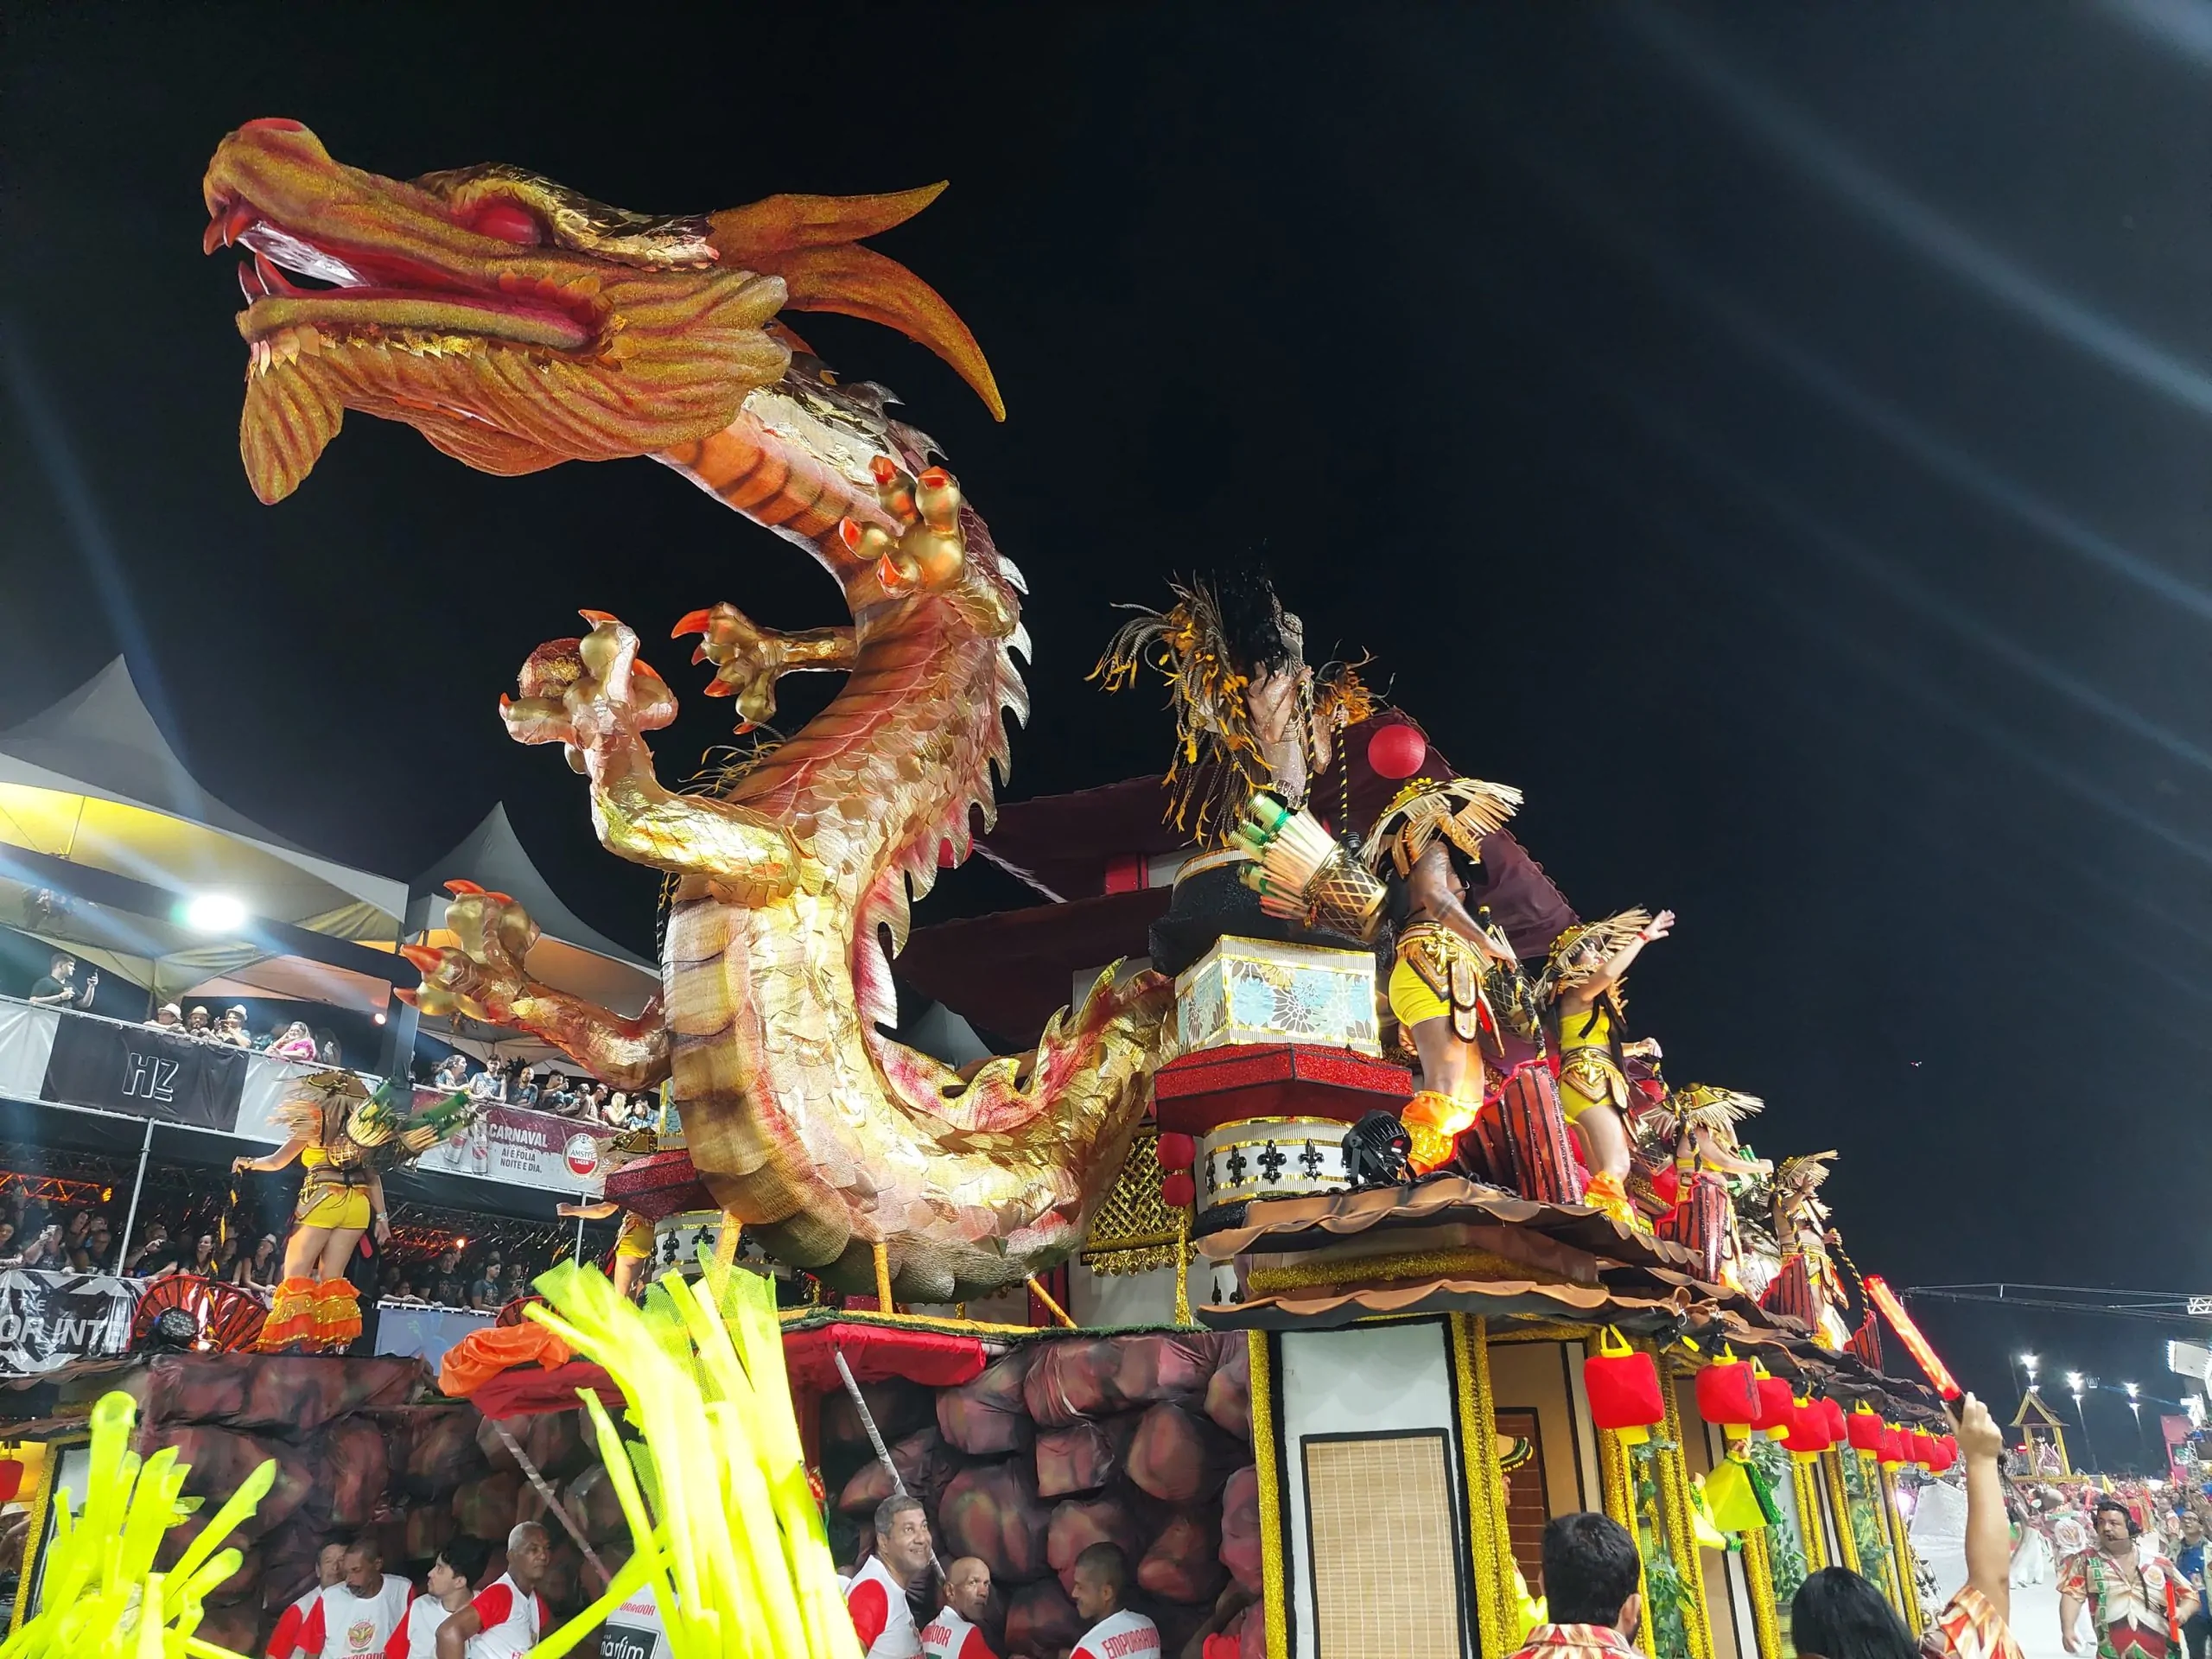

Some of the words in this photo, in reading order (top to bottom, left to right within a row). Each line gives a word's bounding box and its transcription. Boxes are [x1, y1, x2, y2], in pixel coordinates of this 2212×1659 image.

[122, 1052, 179, 1102] HZ
[489, 1123, 548, 1148] CARNAVAL
[500, 1158, 522, 1170] NOITE
[523, 1162, 528, 1171] E
[528, 1163, 543, 1173] DIA.
[516, 1150, 536, 1162] FOLIA
